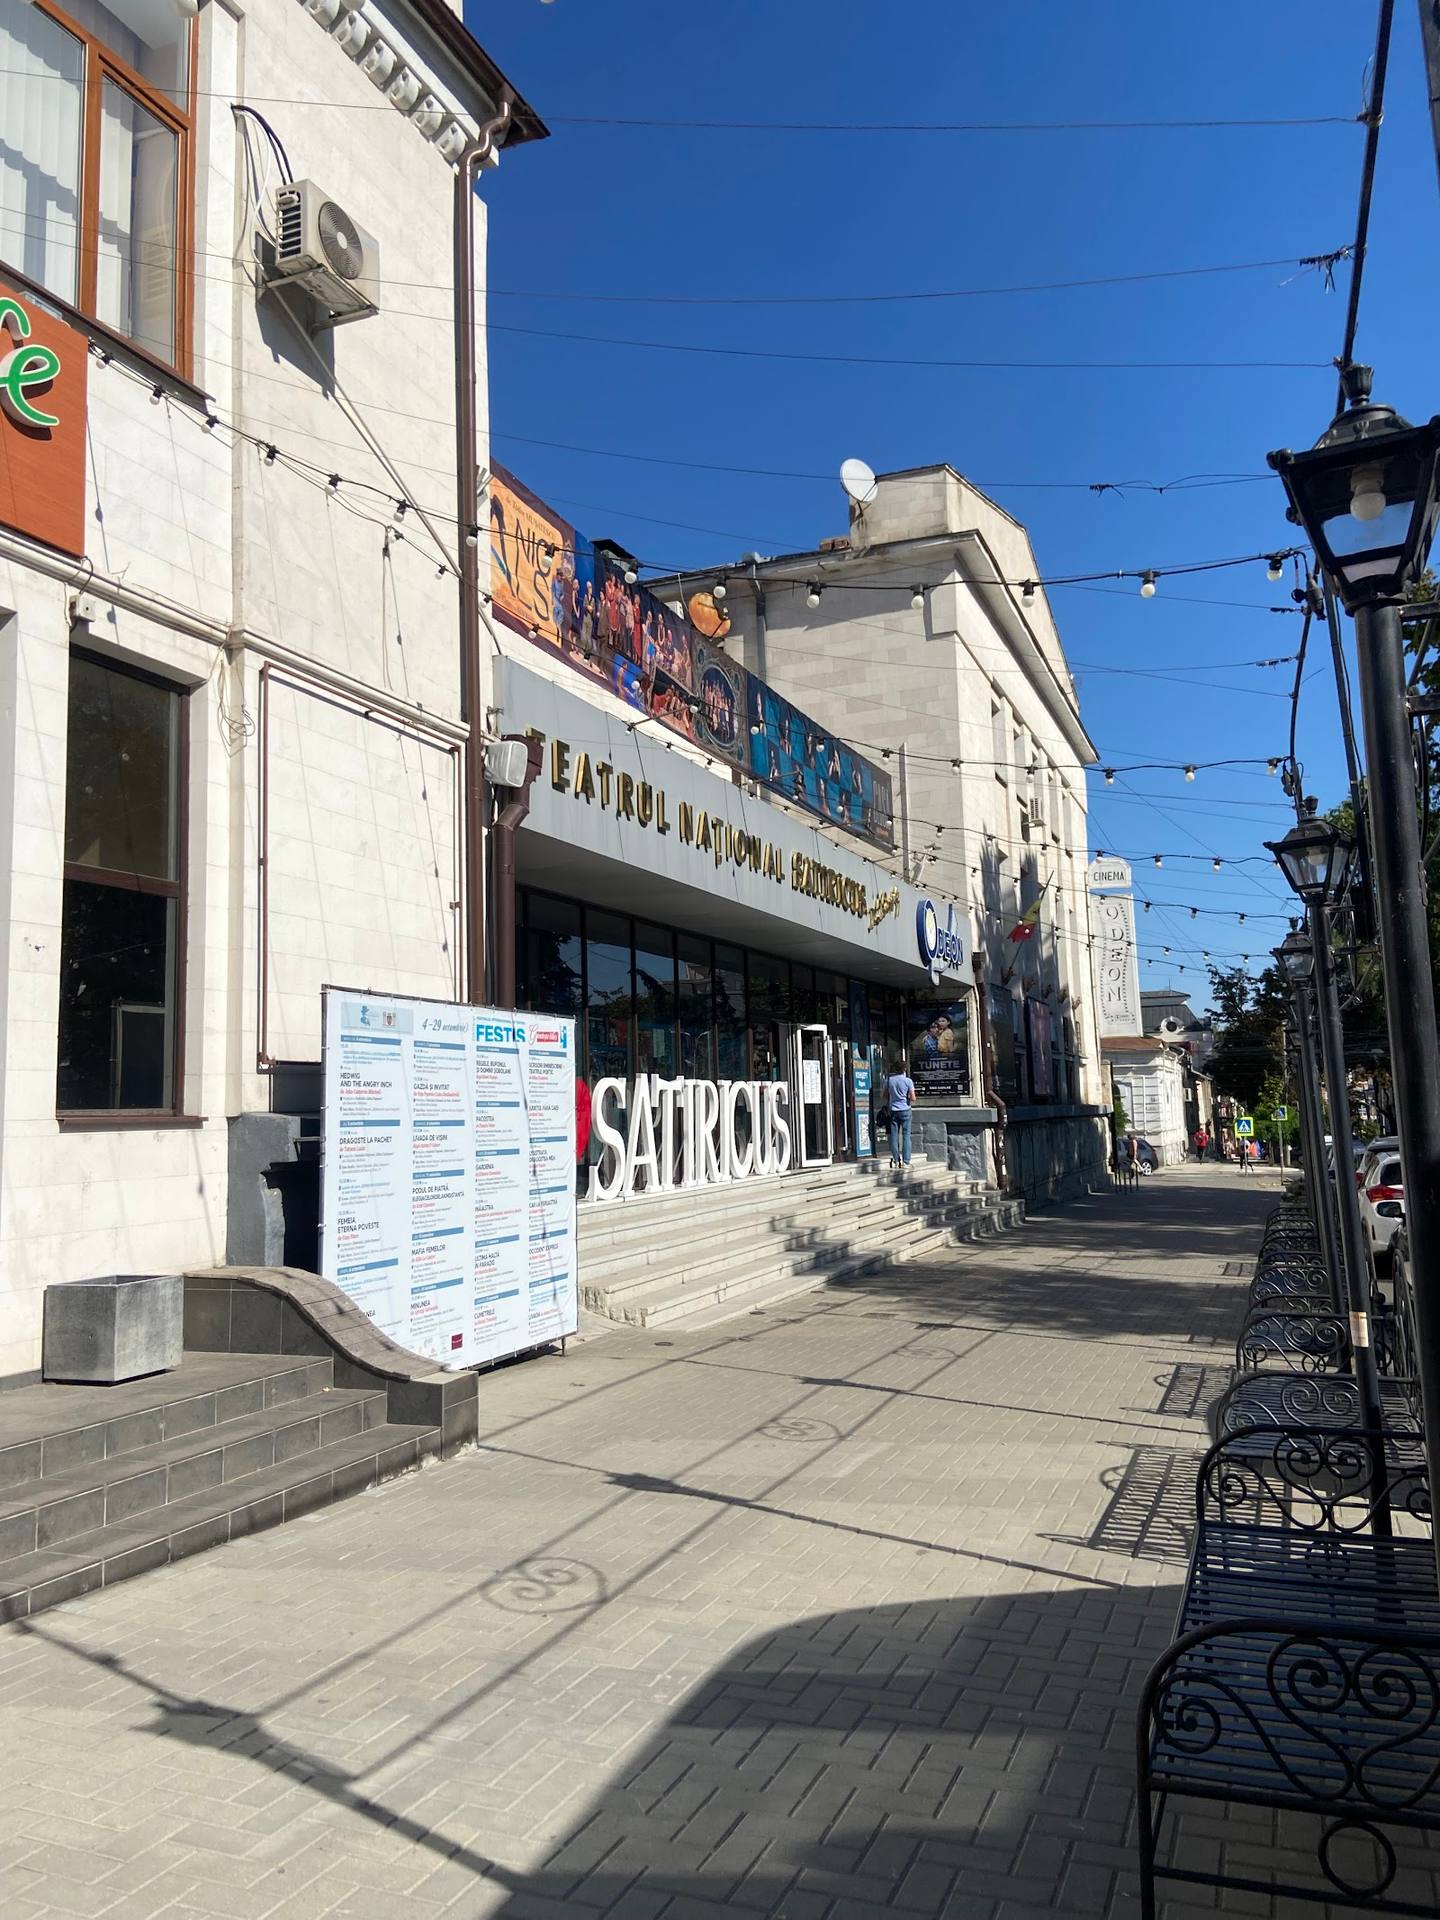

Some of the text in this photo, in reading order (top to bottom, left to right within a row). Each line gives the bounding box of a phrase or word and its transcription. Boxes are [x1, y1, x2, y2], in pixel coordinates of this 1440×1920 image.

[1093, 871, 1125, 882] CINEMA
[340, 1072, 361, 1080] HEDWIG
[340, 1080, 351, 1088] AND
[339, 1137, 366, 1145] DRAGOSTE
[588, 1072, 791, 1201] SATIRICUS
[337, 1222, 380, 1234] ETERNA POVESTE
